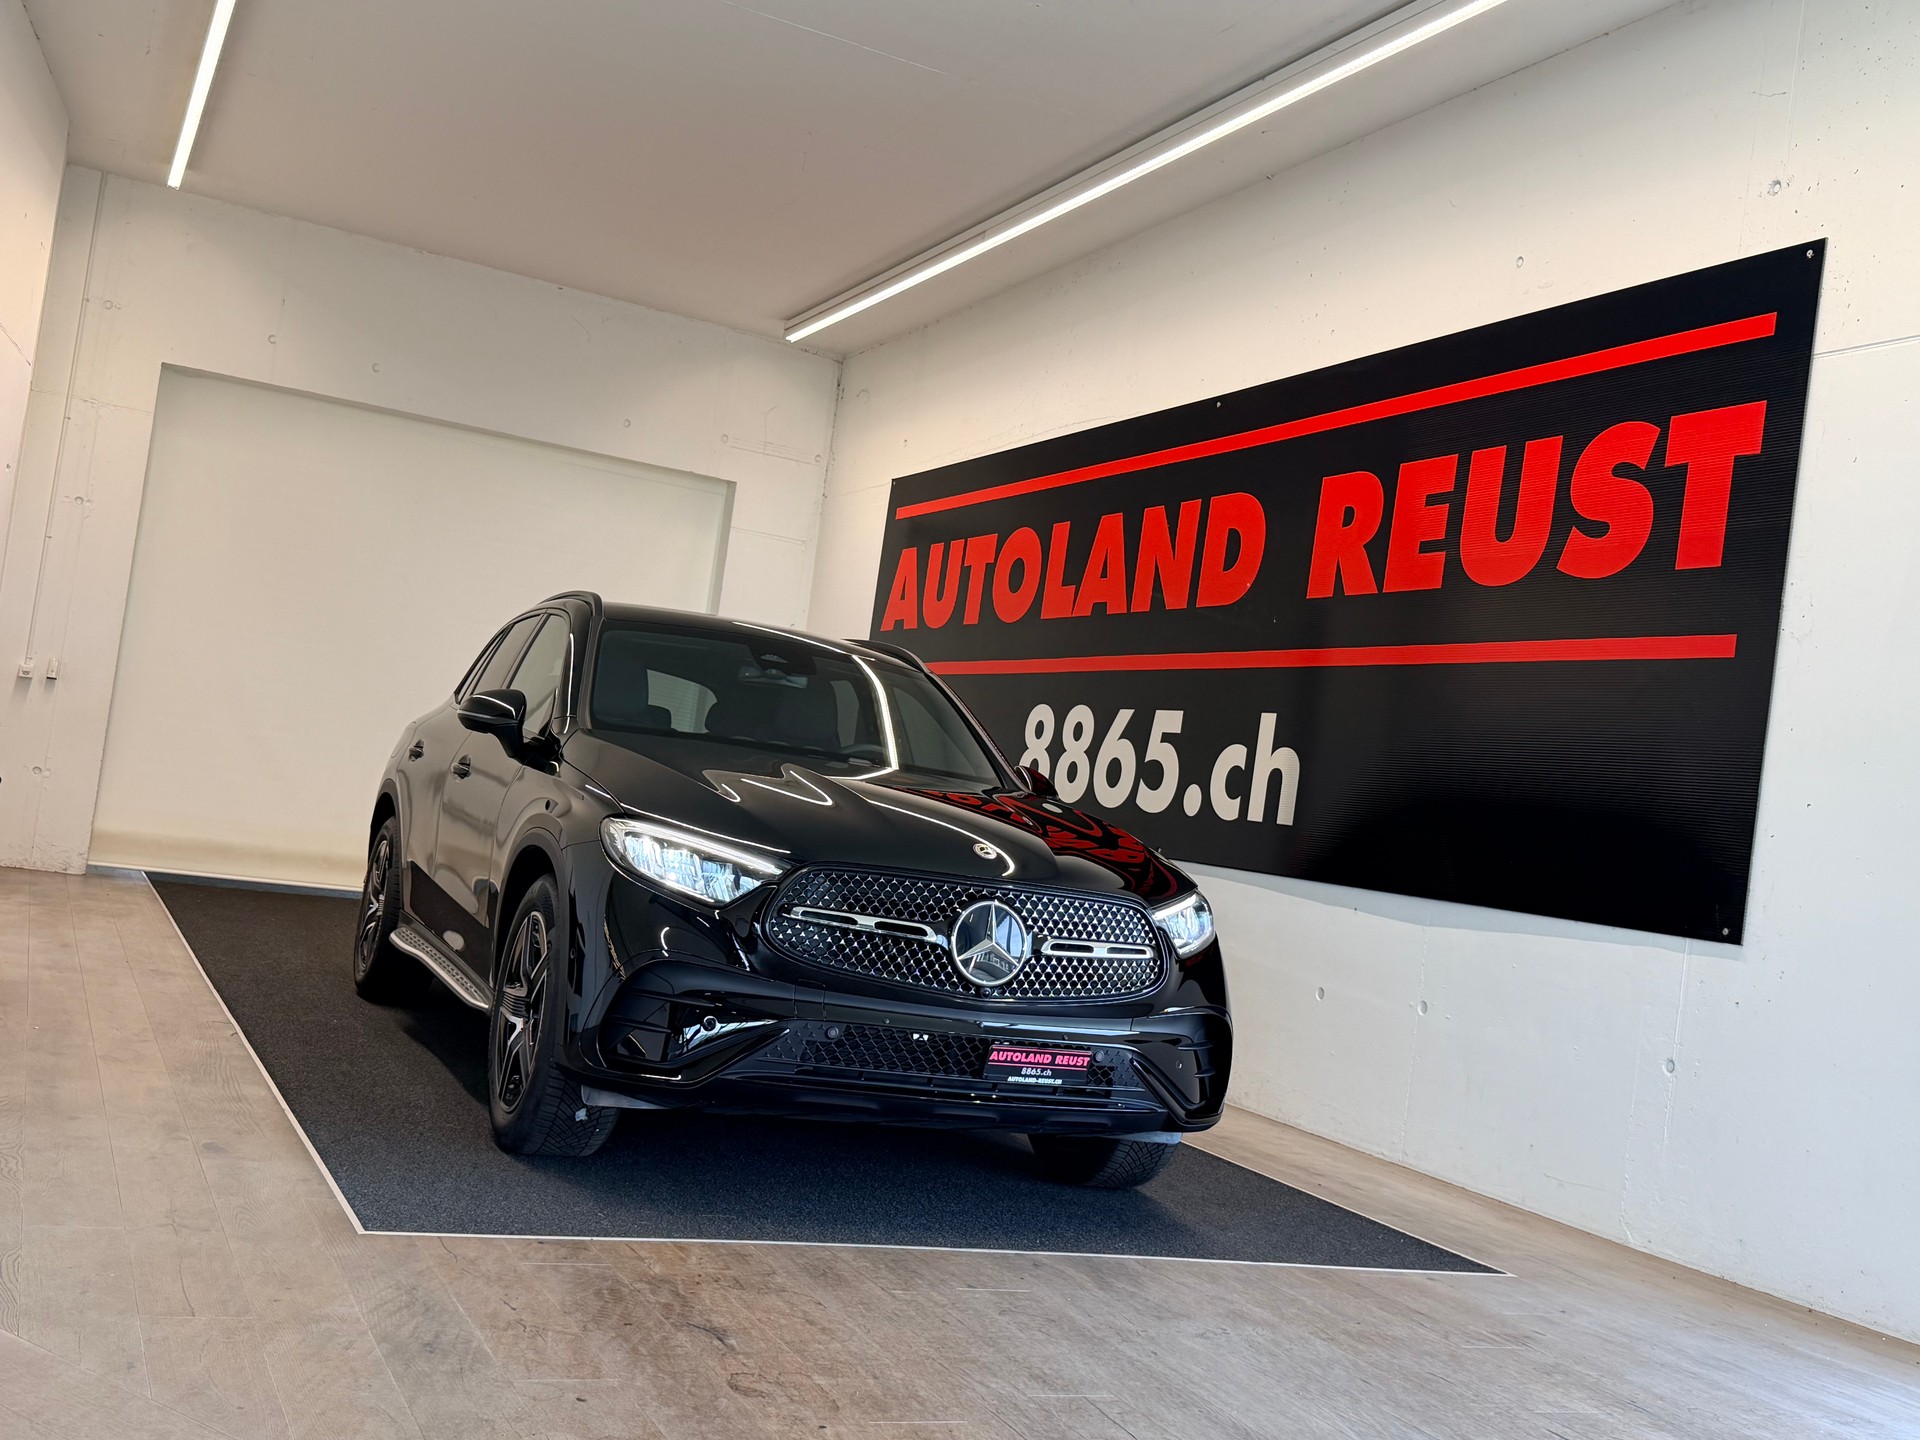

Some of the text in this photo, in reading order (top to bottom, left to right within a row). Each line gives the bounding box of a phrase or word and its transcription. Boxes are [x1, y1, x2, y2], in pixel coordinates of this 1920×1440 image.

[880, 400, 1767, 631] AUTOLAND REUST
[1019, 703, 1301, 826] 8865.ch
[989, 1051, 1090, 1066] AUTOLAND REUST
[1021, 1067, 1052, 1075] 8865.ch
